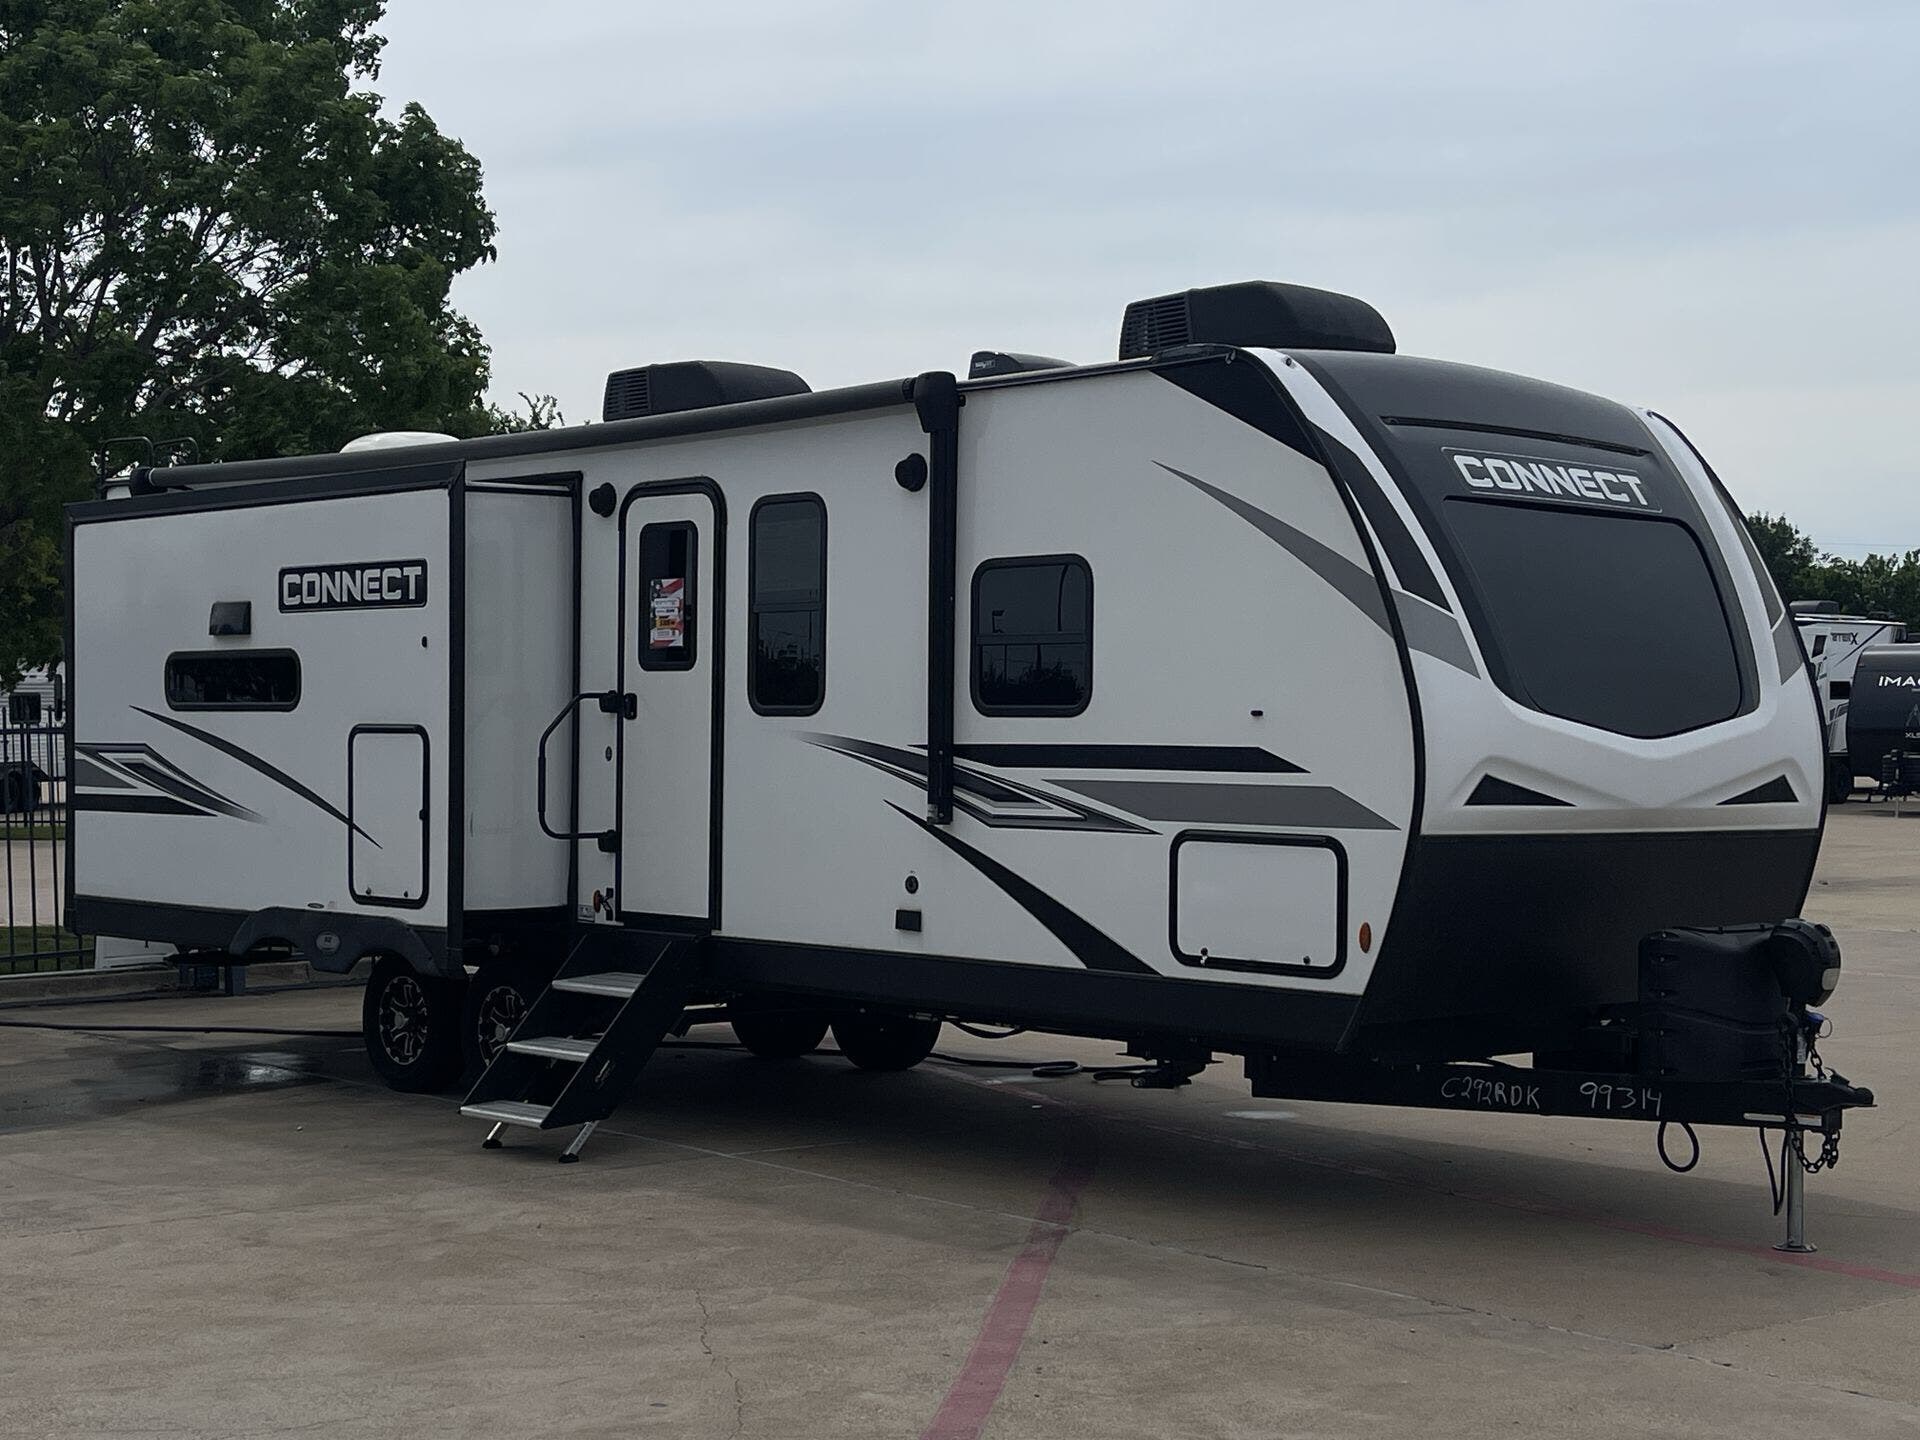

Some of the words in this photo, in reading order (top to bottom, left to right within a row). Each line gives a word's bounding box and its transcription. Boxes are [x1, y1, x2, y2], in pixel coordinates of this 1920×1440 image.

[1453, 454, 1648, 506] CONNECT
[282, 565, 423, 607] CONNECT
[1878, 675, 1920, 687] IMA
[1440, 1076, 1540, 1110] C292RDK
[1580, 1081, 1662, 1117] 99314
